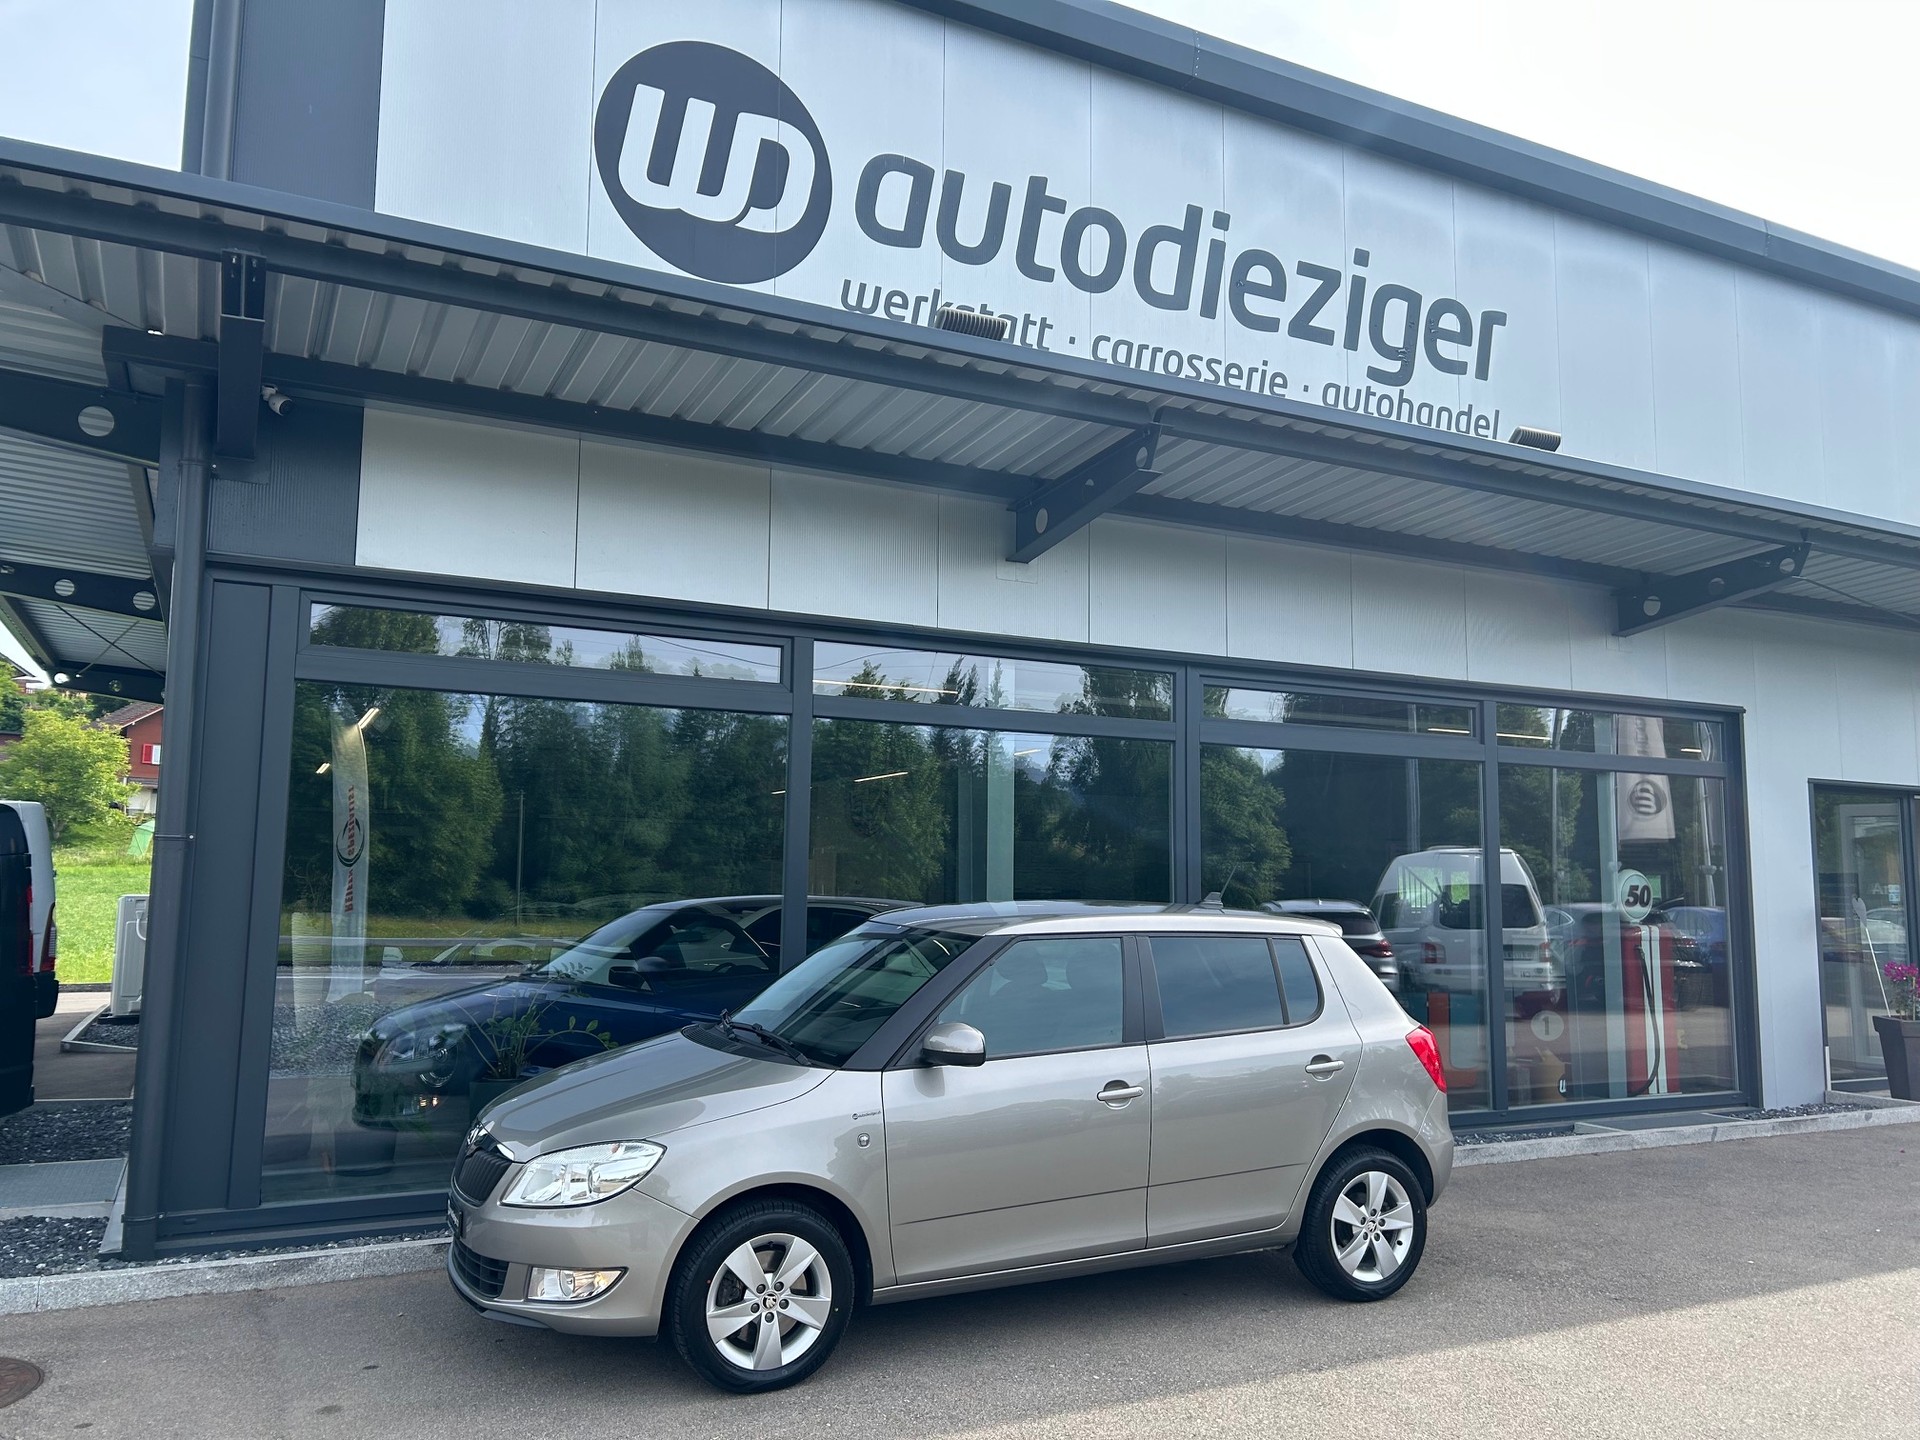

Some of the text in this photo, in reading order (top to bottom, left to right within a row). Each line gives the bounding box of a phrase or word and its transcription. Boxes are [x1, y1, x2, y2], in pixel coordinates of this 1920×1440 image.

[855, 153, 1508, 388] autodieziger
[1091, 334, 1289, 398] carrosserie
[1322, 382, 1500, 440] autohandel
[1624, 884, 1651, 908] 50
